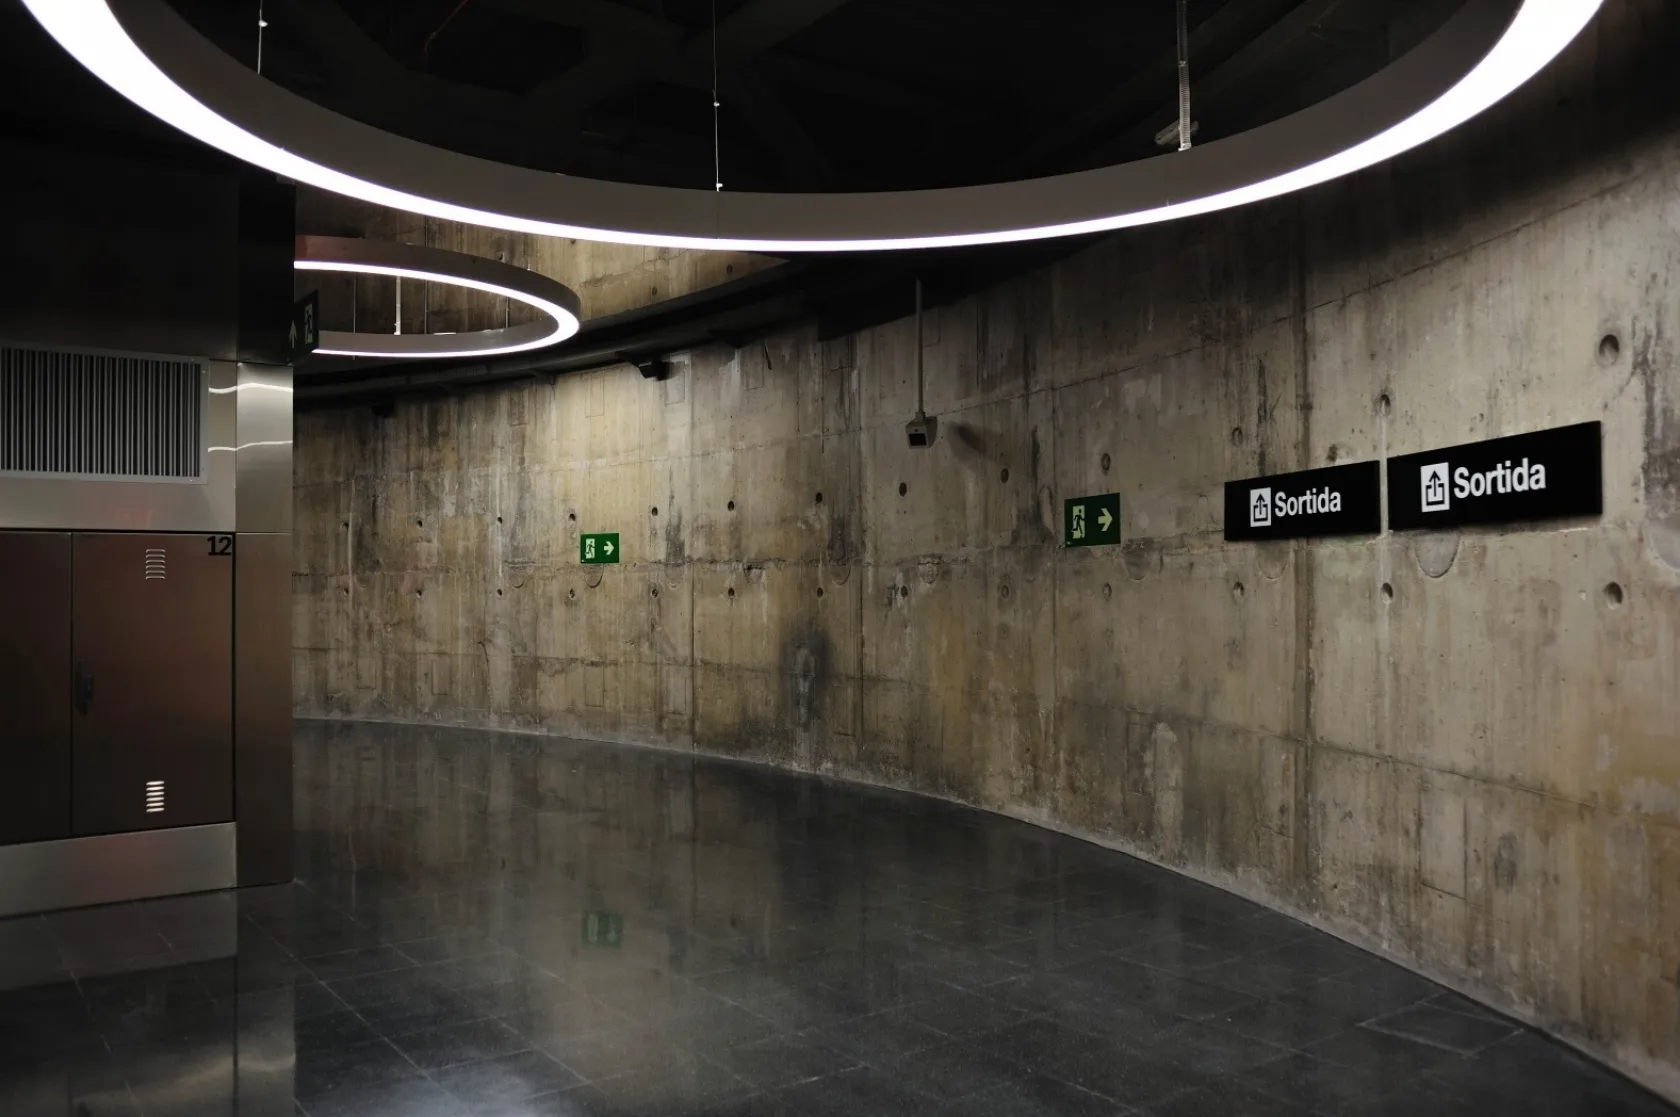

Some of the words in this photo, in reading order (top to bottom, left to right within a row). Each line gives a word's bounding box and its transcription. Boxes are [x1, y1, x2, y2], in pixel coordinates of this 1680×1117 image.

[1453, 457, 1546, 499] Sortida
[1274, 486, 1342, 517] Sortida
[207, 536, 232, 556] 12
